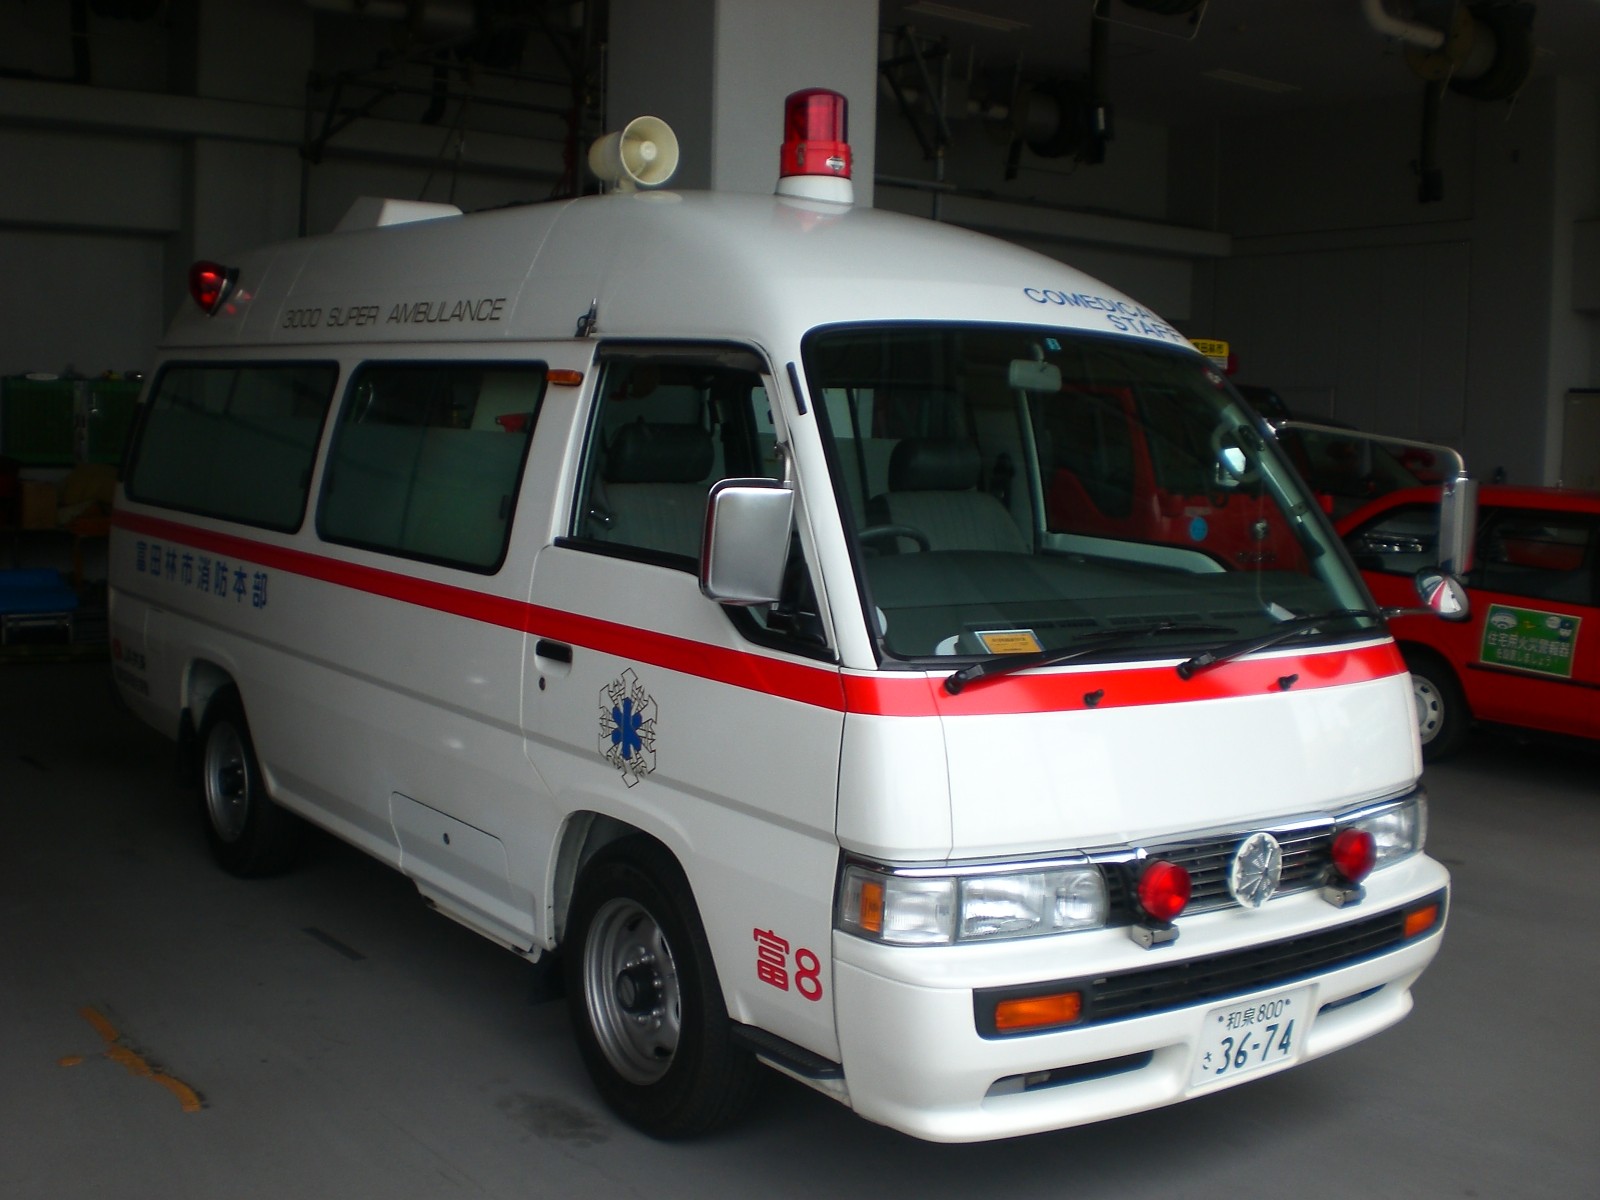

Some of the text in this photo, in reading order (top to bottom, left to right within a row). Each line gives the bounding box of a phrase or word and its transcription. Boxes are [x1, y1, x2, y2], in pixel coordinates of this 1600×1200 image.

[282, 298, 506, 329] 3000 SUPER AMBULANCE
[1107, 314, 1181, 342] STAFF
[136, 541, 268, 609] 富田林市消防本部
[1215, 1019, 1294, 1075] 36-74
